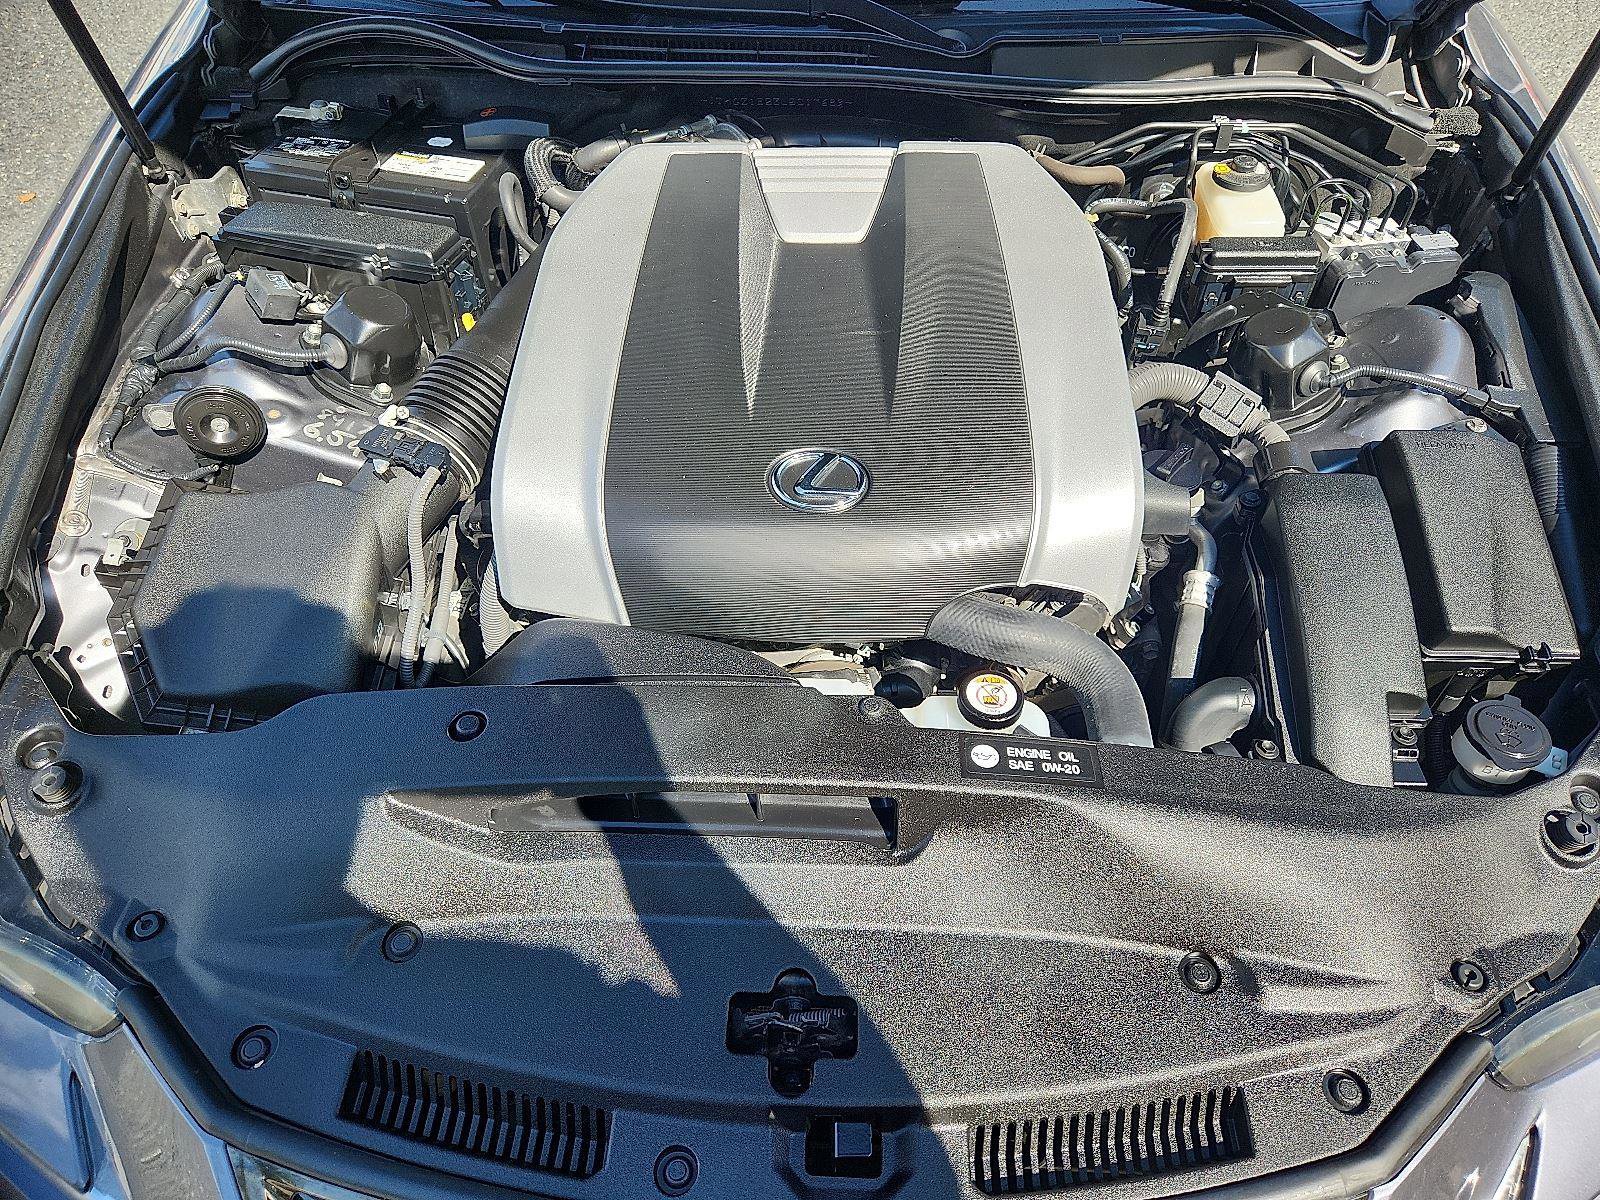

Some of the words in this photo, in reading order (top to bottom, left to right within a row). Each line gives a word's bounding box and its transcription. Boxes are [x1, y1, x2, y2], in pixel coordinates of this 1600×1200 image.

[1006, 746, 1051, 759] ENGINE
[1058, 751, 1079, 762] OIL
[1008, 760, 1034, 771] SAE
[1042, 763, 1080, 774] 0W-20
